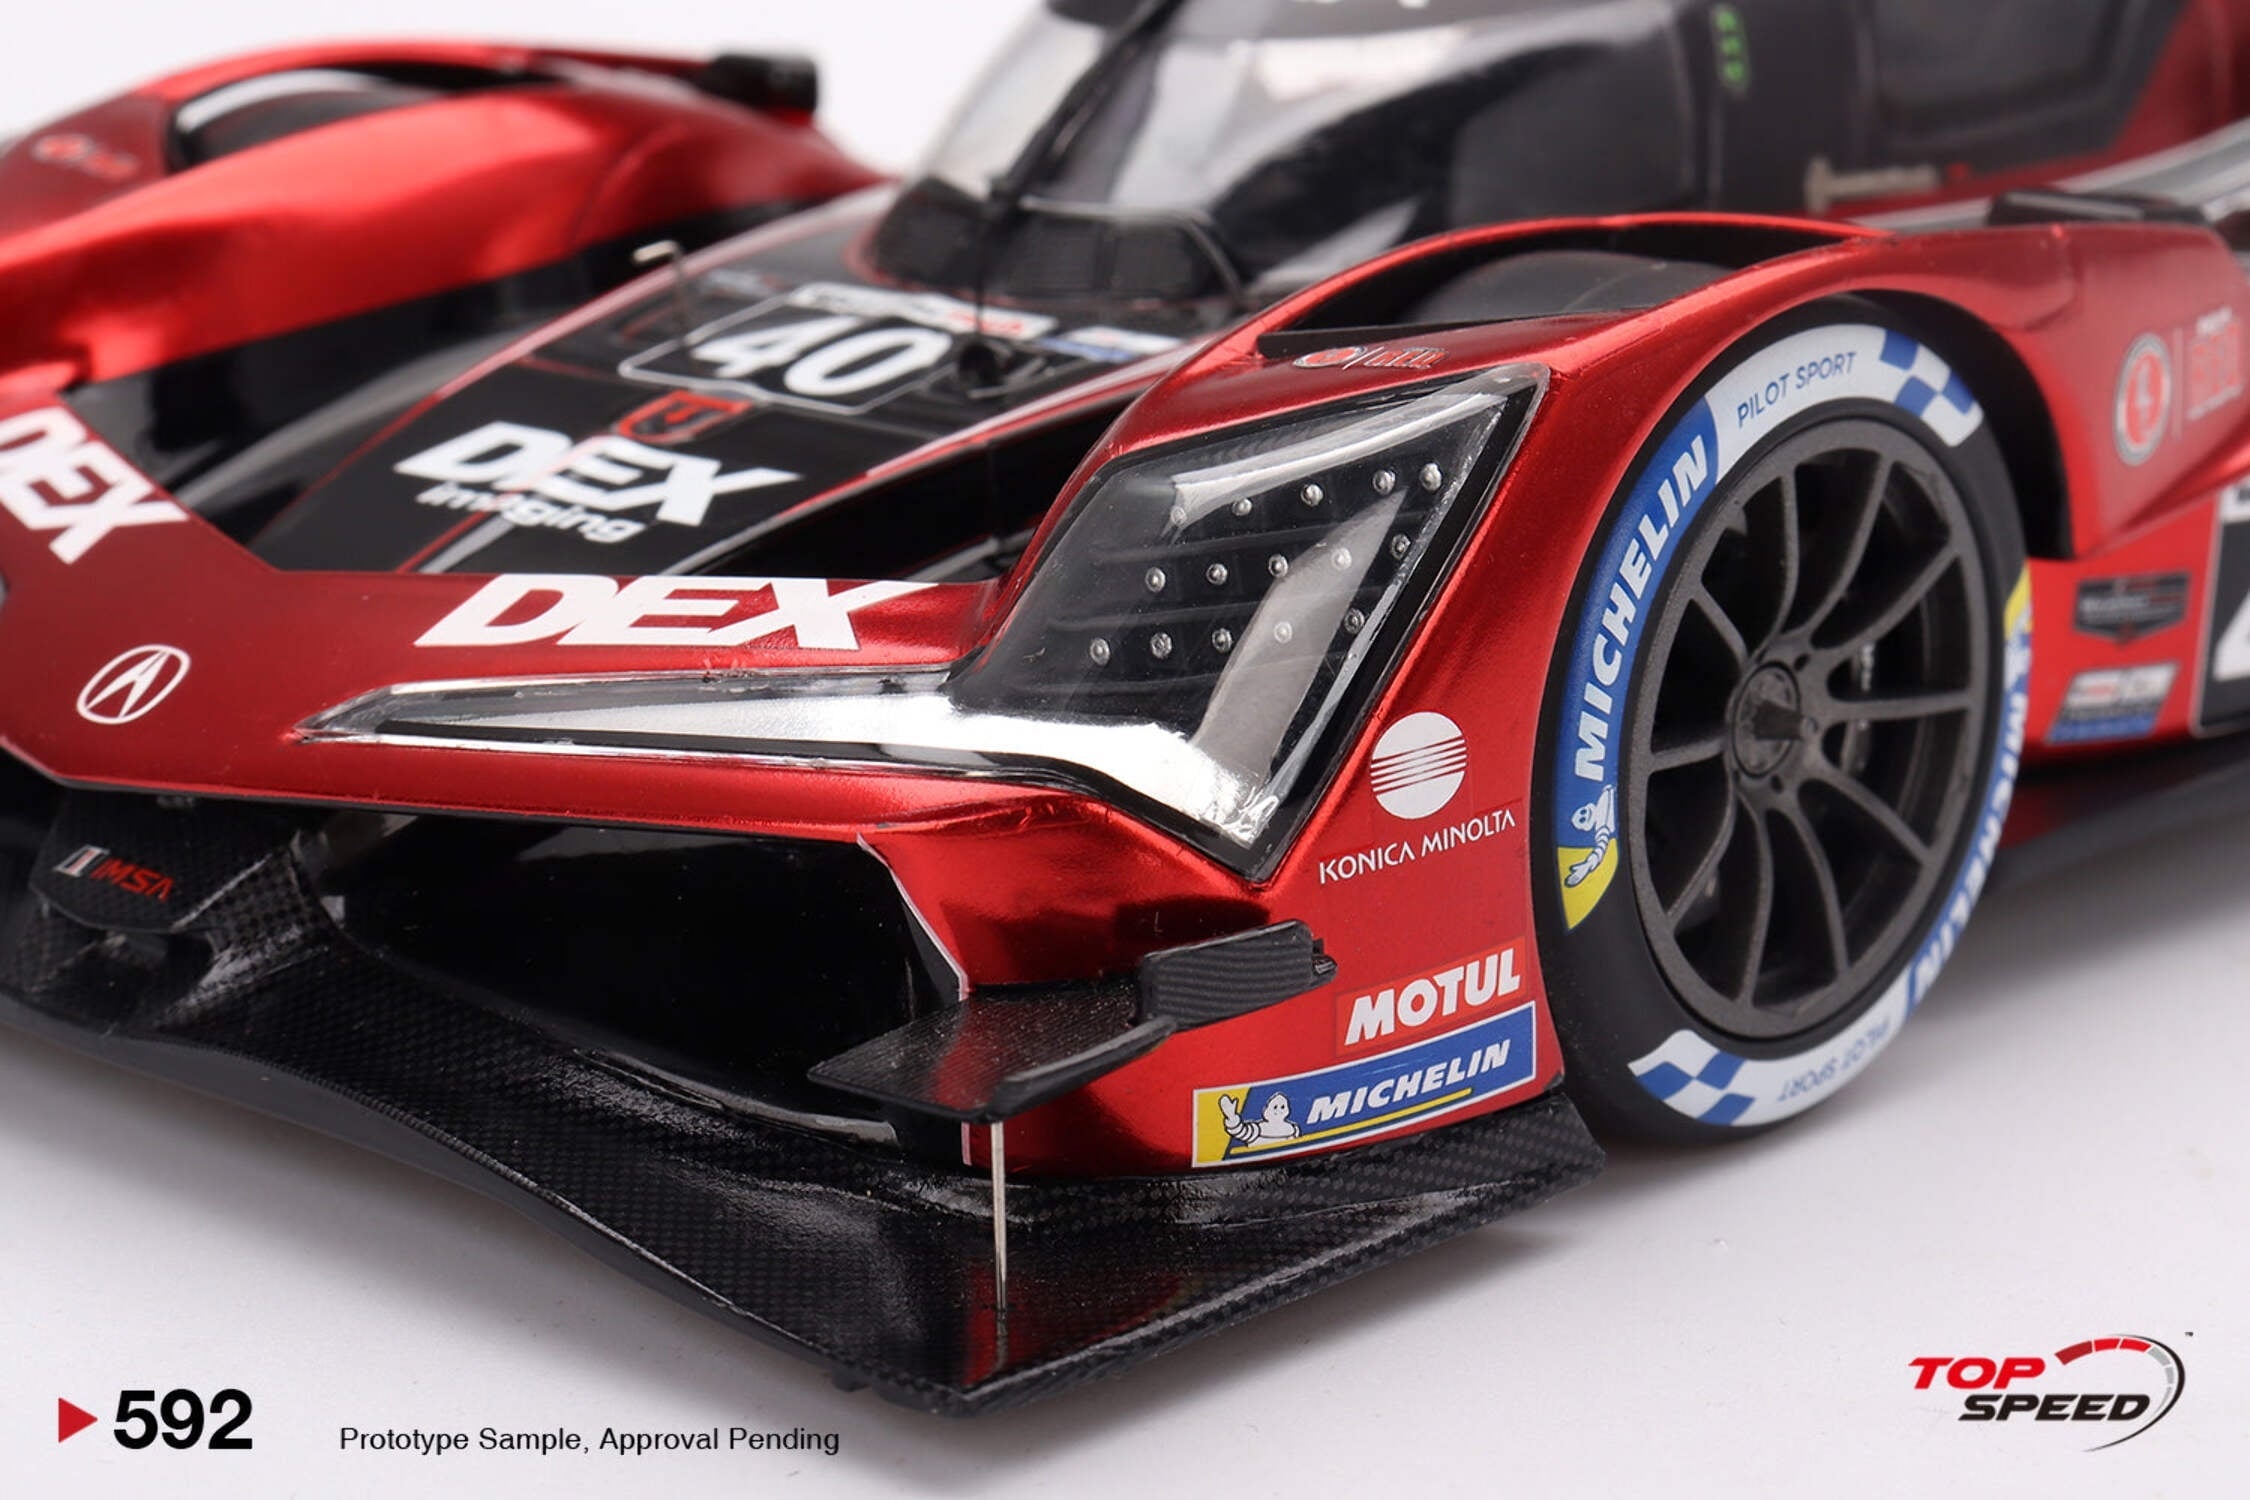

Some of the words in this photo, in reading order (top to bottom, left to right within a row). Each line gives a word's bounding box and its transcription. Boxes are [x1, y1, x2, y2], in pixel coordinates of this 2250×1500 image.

[691, 315, 951, 396] 40
[1737, 373, 1790, 429] PILOT
[1795, 352, 1856, 389] SPORT
[393, 421, 801, 526] DEX
[413, 574, 939, 650] DEX
[1575, 435, 1708, 782] MICHELIN
[1318, 839, 1415, 884] KONICA
[1420, 809, 1516, 855] MINOLTA
[1344, 948, 1521, 1046] MOTUL
[1306, 1038, 1511, 1124] MICHELIN
